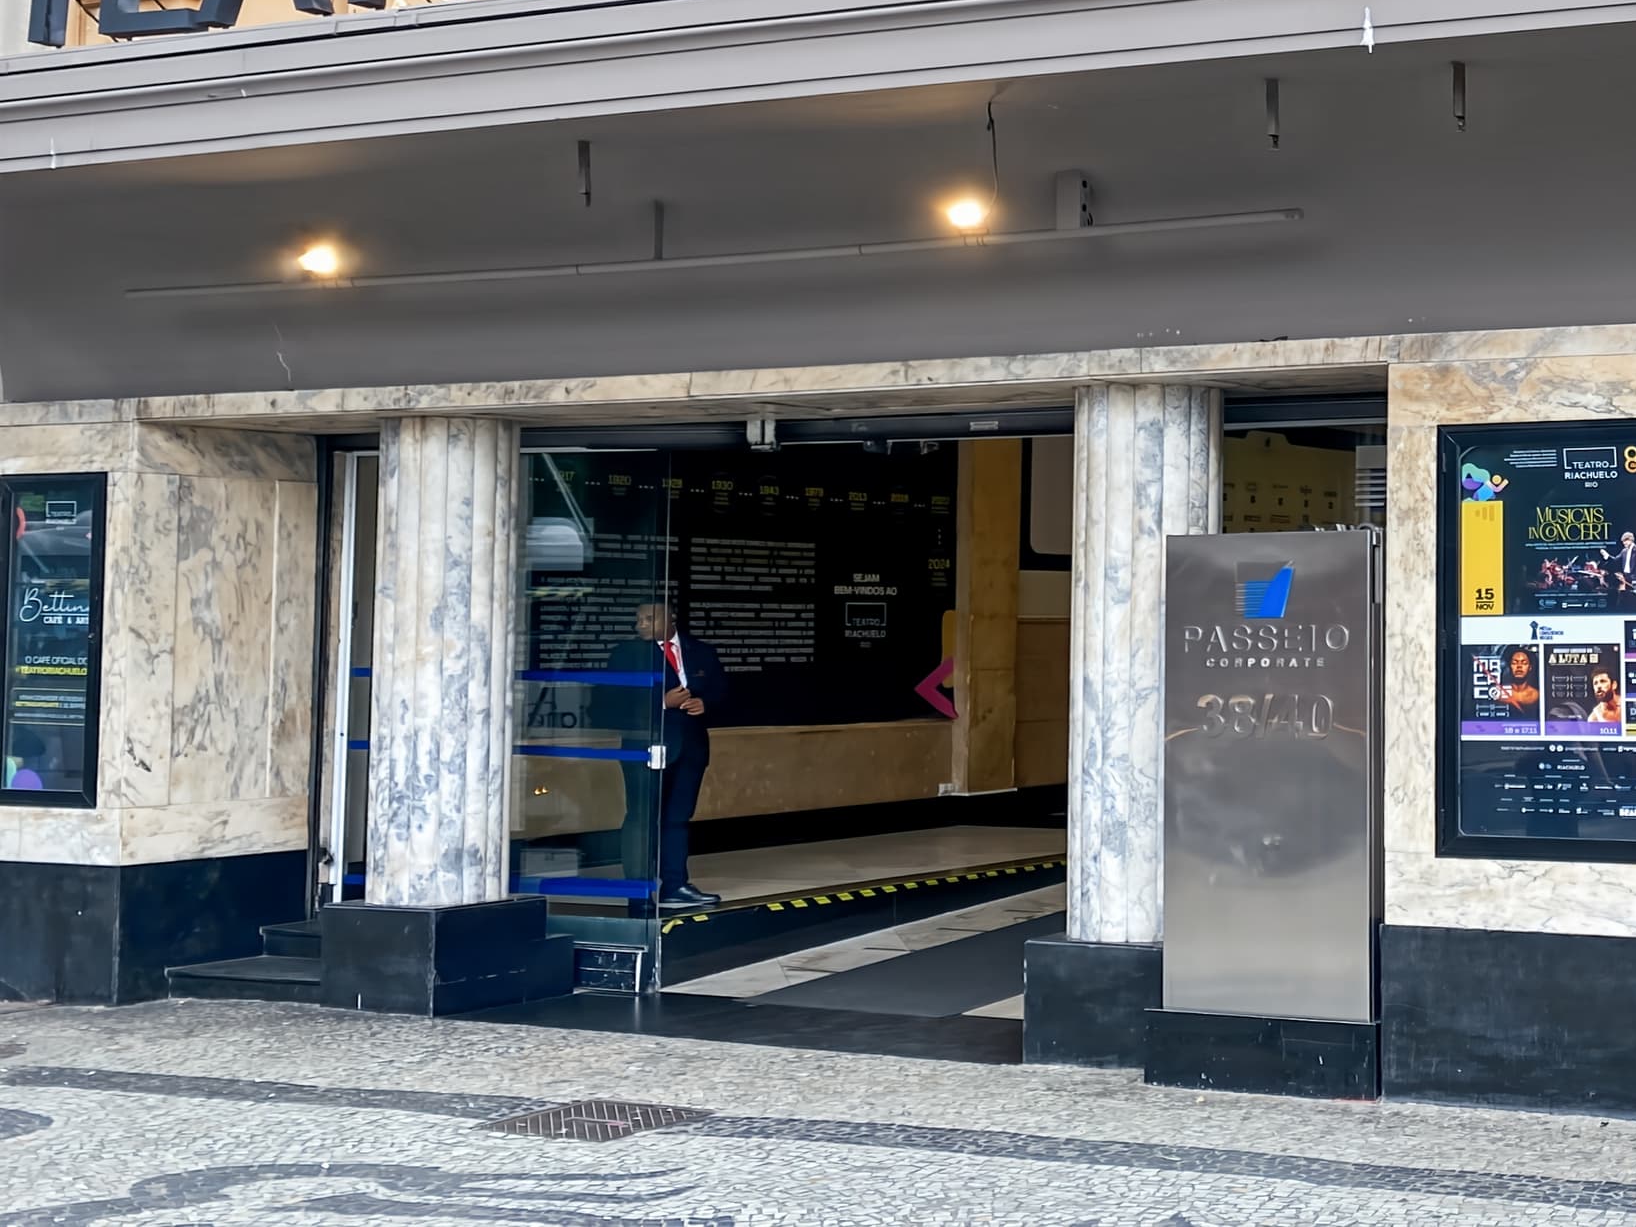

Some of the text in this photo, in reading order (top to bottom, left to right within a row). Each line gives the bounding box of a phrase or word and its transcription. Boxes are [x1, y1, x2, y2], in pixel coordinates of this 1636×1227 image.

[1572, 460, 1610, 469] TEATRO
[1564, 470, 1618, 480] RIACHUELO
[1536, 506, 1604, 525] MUSICAIS
[1528, 522, 1612, 542] IN CONCERT
[1475, 588, 1494, 600] 15
[1475, 602, 1494, 611] NOV
[1183, 623, 1350, 653] PASSEIO
[1206, 656, 1326, 668] CORPORATE
[1196, 693, 1335, 741] 38/40
